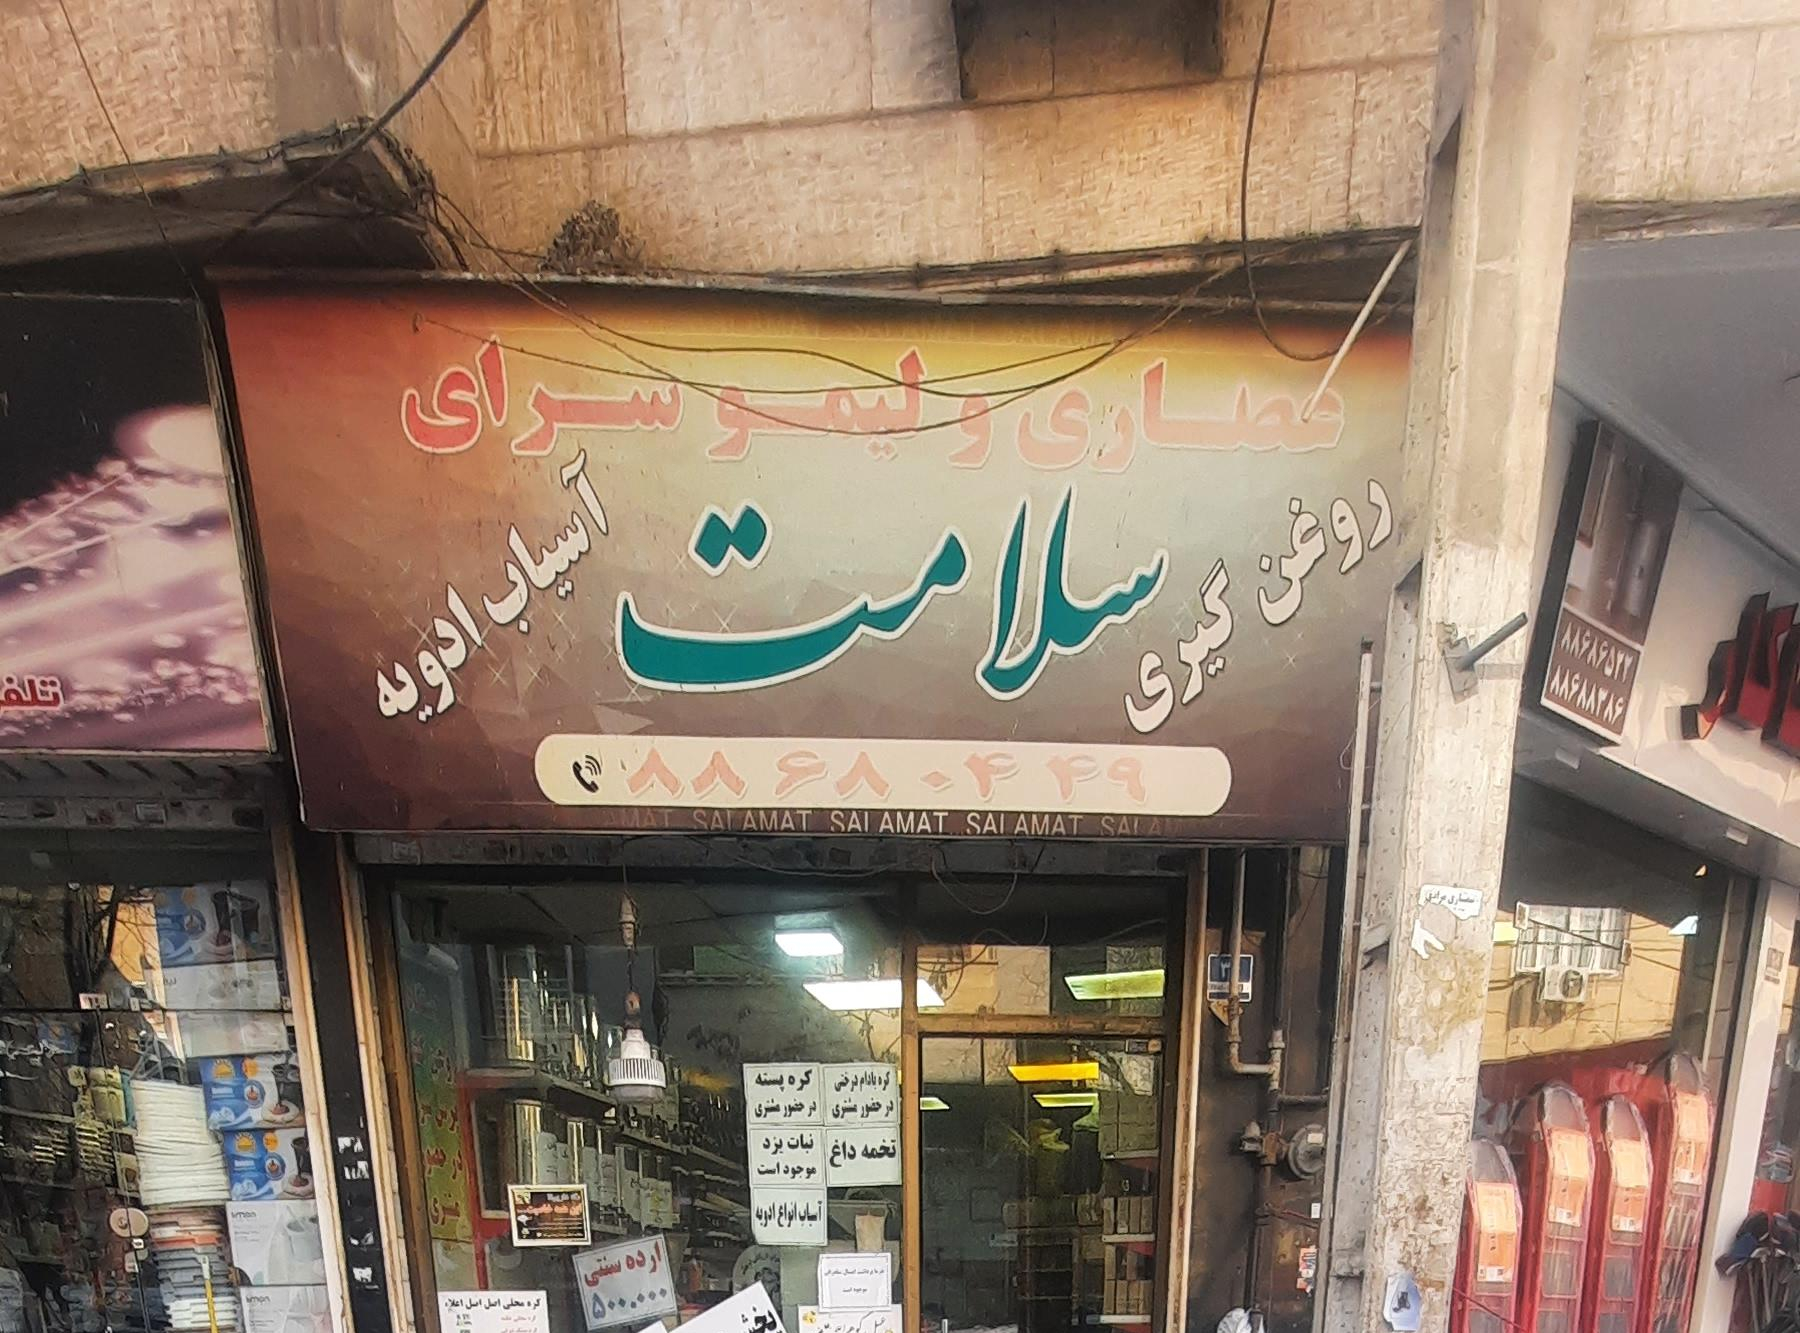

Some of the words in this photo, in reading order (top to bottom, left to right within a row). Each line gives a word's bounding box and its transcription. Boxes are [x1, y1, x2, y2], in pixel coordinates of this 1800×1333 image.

[401, 336, 684, 456] سرای
[706, 347, 928, 461] لیمو
[947, 375, 994, 470] و
[1015, 357, 1346, 473] عصاری
[482, 449, 610, 633] آسیاب
[1258, 480, 1393, 628] روغن
[616, 484, 1170, 700] سلامت
[376, 582, 485, 722] ادویه
[1124, 558, 1233, 733] گیری
[0, 676, 61, 707] تلف
[693, 809, 812, 832] SALAMAT
[830, 811, 949, 834] SALAMAT
[966, 811, 1084, 836] SALAMAT
[755, 1072, 784, 1092] پسته
[788, 1069, 813, 1091] کره
[754, 1098, 780, 1119] مشتری
[784, 1098, 805, 1118] حضور
[808, 1100, 817, 1117] در
[832, 1098, 858, 1119] مشتری
[860, 1098, 882, 1118] حضور
[885, 1100, 894, 1117] در
[762, 1136, 783, 1155] یزد
[787, 1132, 814, 1153] نبات
[829, 1139, 857, 1168] داغ
[861, 1139, 897, 1160] تخمه
[757, 1162, 780, 1175] است
[783, 1164, 817, 1179] موجود
[755, 1202, 775, 1227] ادویه
[777, 1201, 797, 1228] انواع
[798, 1201, 822, 1227] آسیاب
[584, 1255, 622, 1287] سنتی
[503, 1298, 525, 1310] محلی
[527, 1298, 541, 1310] کره
